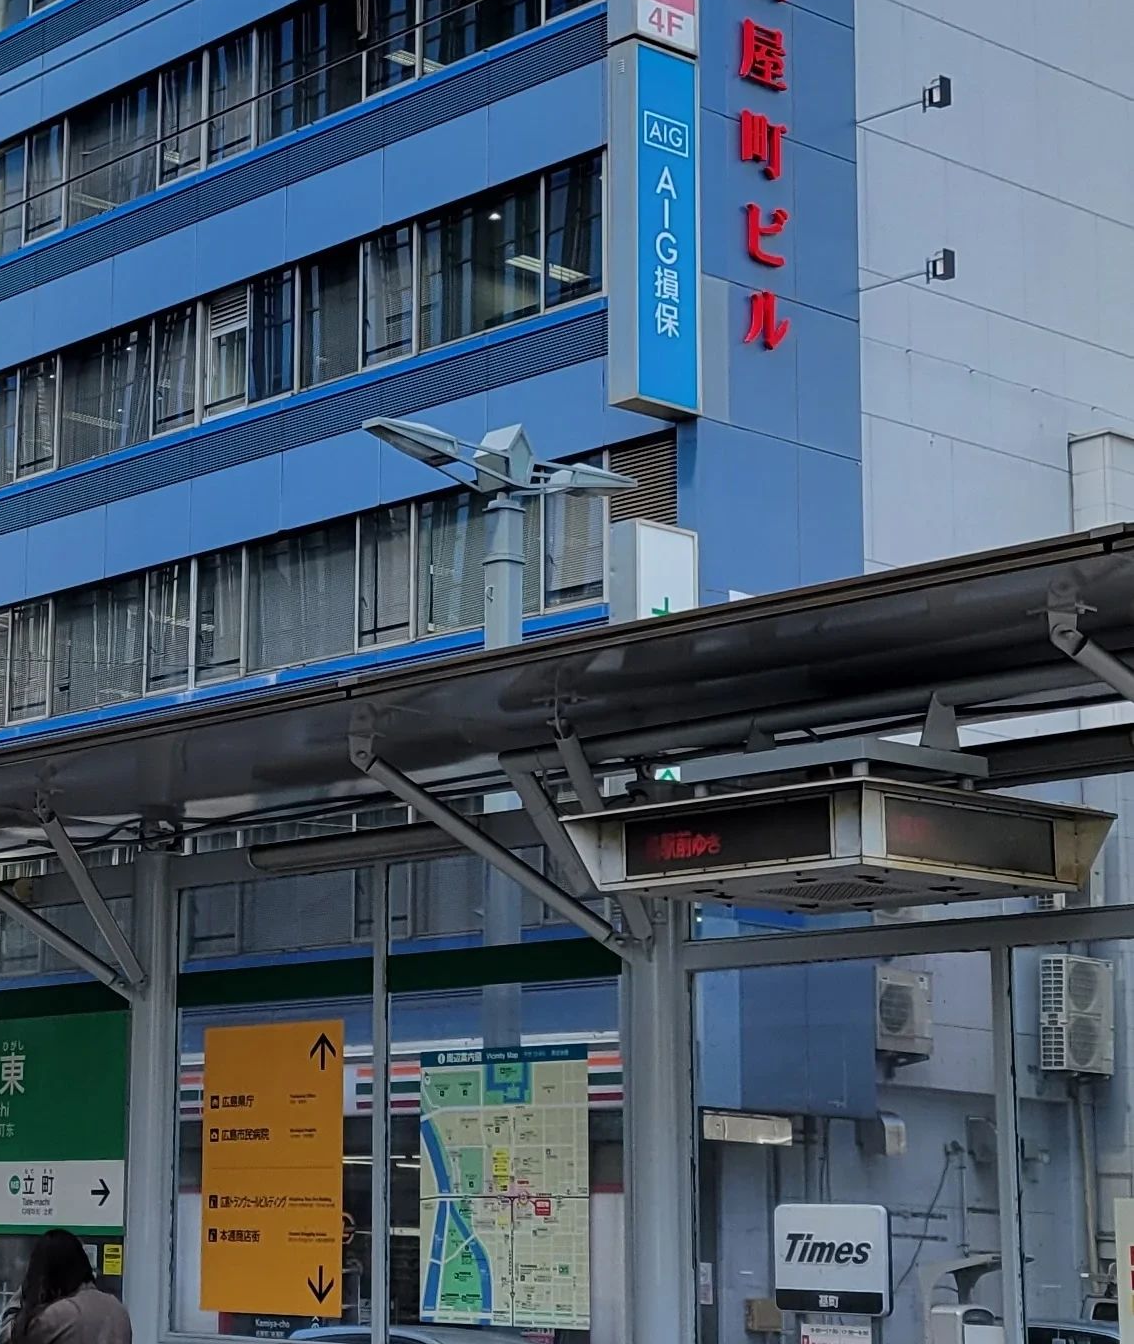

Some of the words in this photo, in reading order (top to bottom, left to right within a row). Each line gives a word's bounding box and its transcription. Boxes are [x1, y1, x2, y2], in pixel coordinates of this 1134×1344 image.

[648, 7, 684, 36] 4F
[649, 122, 684, 148] AIG
[654, 166, 680, 339] AIG損保
[2, 1040, 24, 1051] ひがし
[22, 1175, 54, 1195] 立町
[785, 1233, 872, 1265] Times
[255, 1318, 290, 1329] Kamiya-cho
